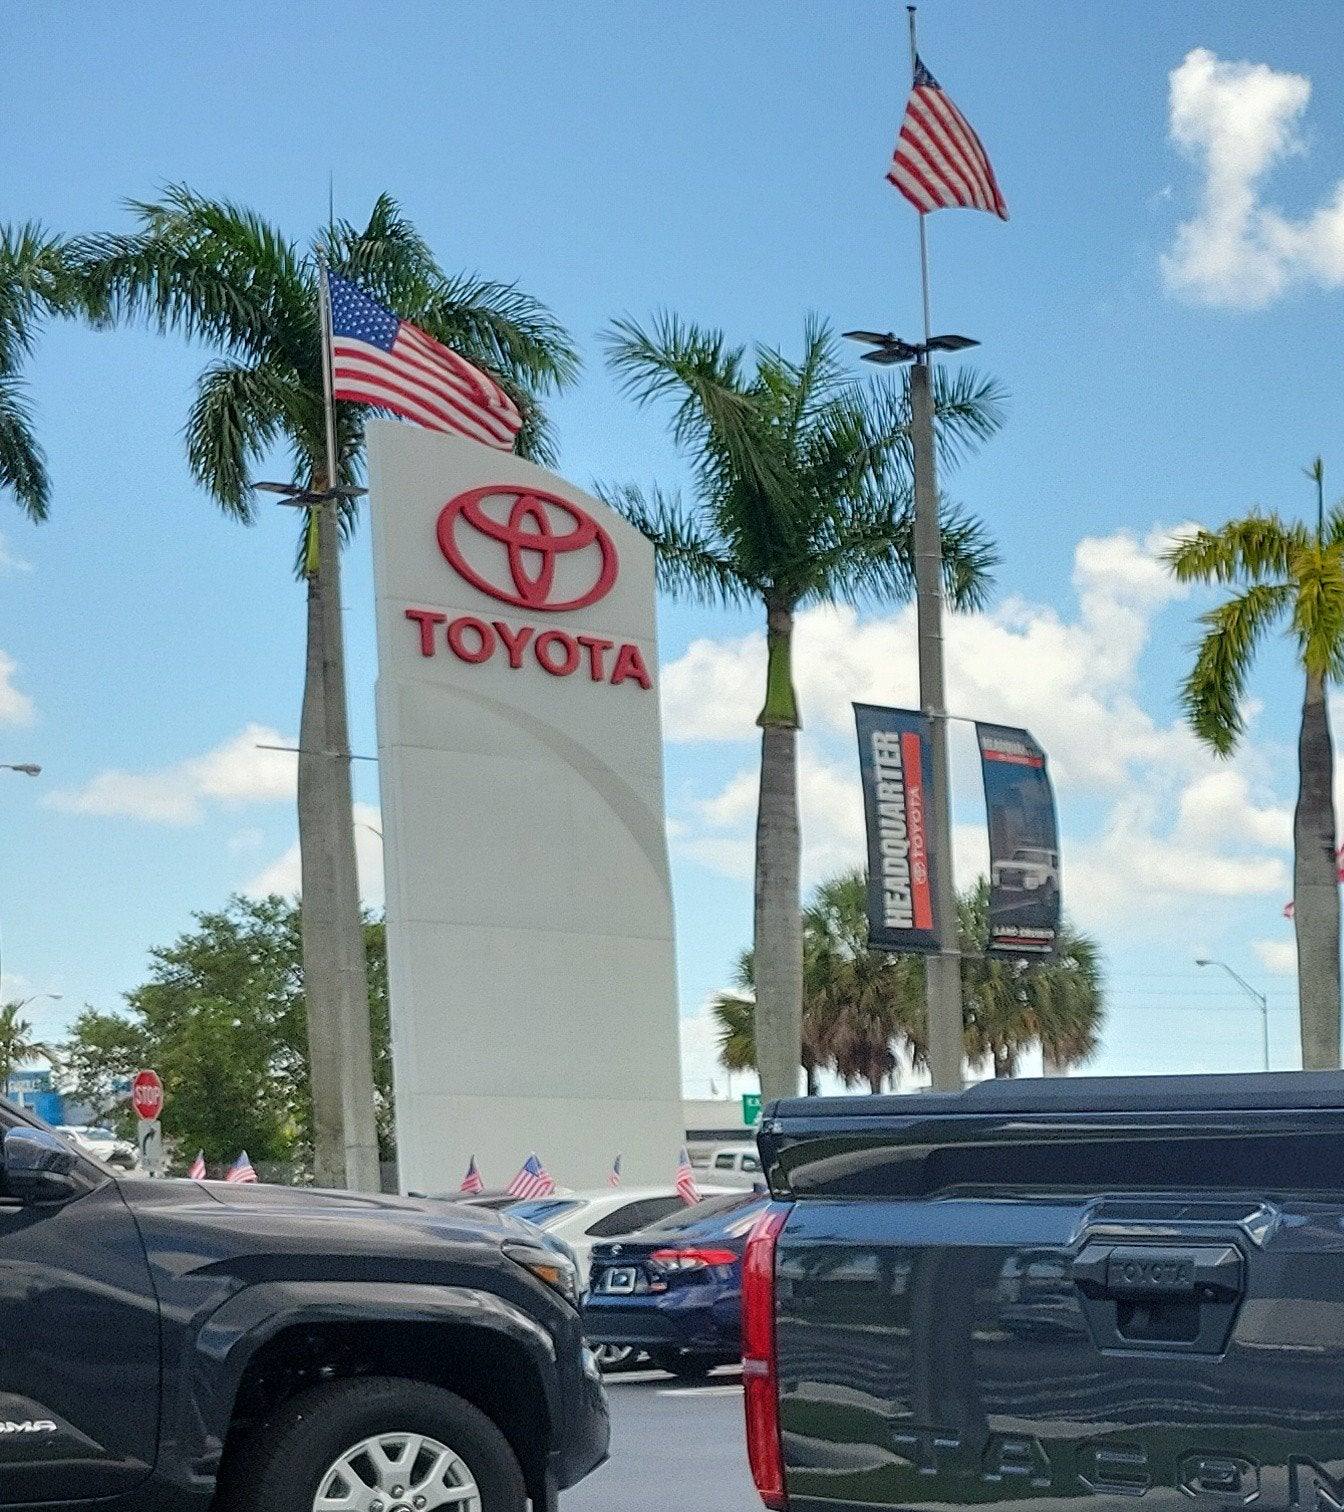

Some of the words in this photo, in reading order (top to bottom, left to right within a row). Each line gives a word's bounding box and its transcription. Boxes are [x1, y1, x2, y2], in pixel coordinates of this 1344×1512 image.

[405, 609, 652, 690] TOYOTA
[872, 731, 913, 929] HEADQUARTER
[908, 787, 925, 858] TOYOTA
[136, 1085, 160, 1105] STOP
[1109, 1260, 1191, 1285] TOYOTA
